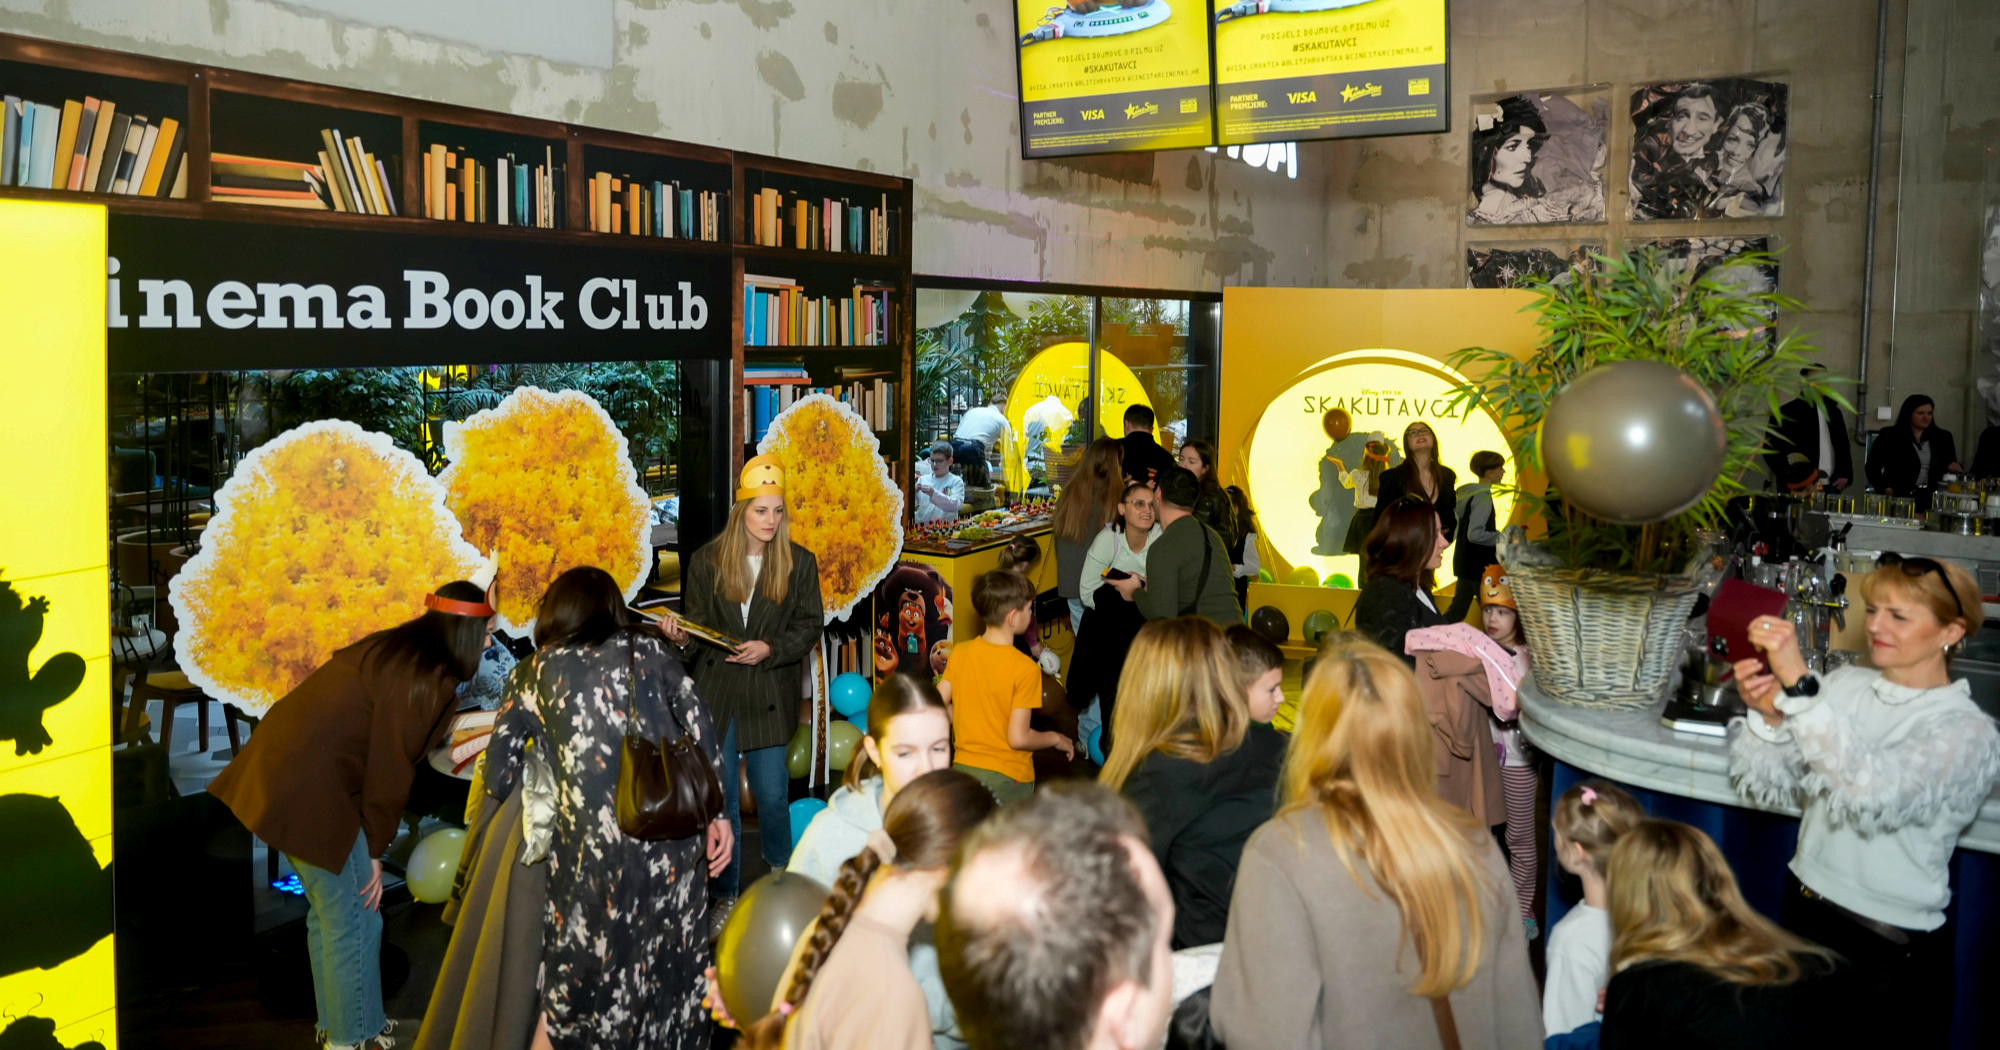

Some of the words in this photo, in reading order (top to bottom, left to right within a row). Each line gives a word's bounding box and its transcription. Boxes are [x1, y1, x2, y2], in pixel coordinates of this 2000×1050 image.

[1261, 30, 1301, 40] PODIJELI
[1303, 25, 1339, 36] DOJMOVE
[1350, 21, 1377, 31] FILMU
[1379, 20, 1390, 28] UZ
[1293, 37, 1357, 52] #SKAKUTAVCI
[1057, 53, 1091, 63] PODIJELI
[1092, 50, 1122, 60] DOJMOVE
[1130, 46, 1153, 55] FILMU
[1155, 45, 1164, 53] UZ
[1083, 61, 1138, 74] #SKAKUTAVCI
[1230, 94, 1259, 102] PARTNER
[1286, 91, 1317, 104] VISA
[1230, 101, 1268, 110] PREMIJERE:
[1033, 111, 1057, 119] PARTNER
[1080, 109, 1105, 121] VISA
[1033, 118, 1065, 126] PREMIJERE:
[107, 257, 392, 330] inema
[403, 269, 564, 330] Book
[579, 277, 709, 330] Club
[1304, 395, 1459, 419] SKAKUTAVCI
